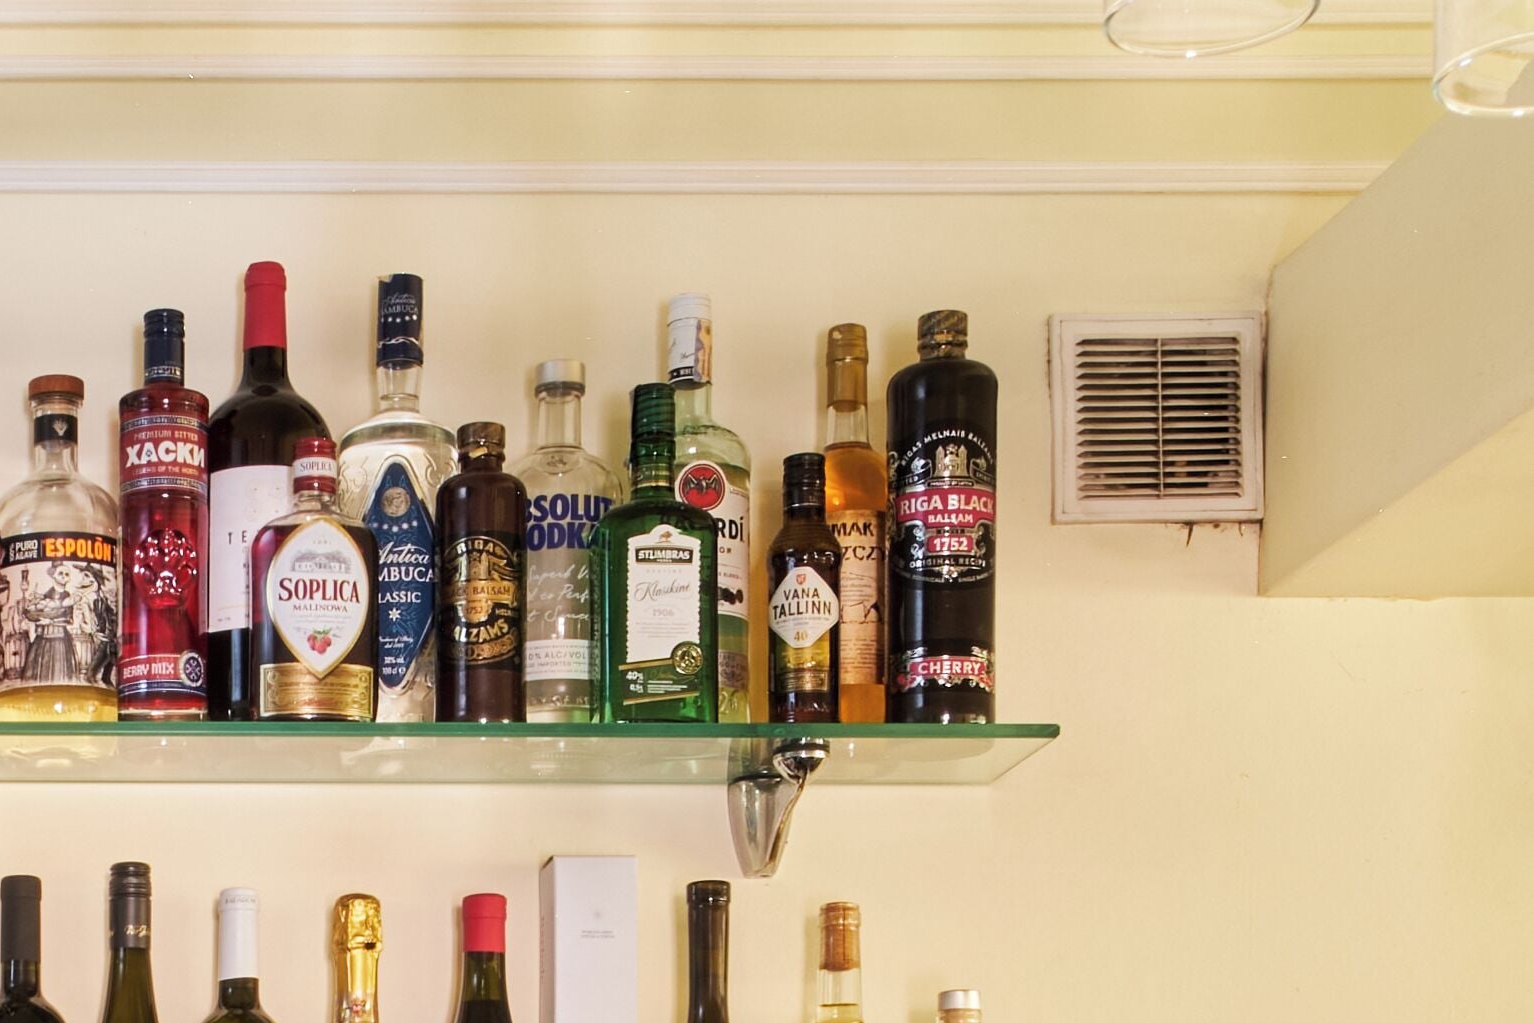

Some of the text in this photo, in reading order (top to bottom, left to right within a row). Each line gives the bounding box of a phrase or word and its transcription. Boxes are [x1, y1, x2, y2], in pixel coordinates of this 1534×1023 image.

[134, 430, 199, 441] PREMIUM BITTER
[924, 429, 966, 443] MELNAIS
[125, 440, 205, 469] ХАСКИ
[299, 461, 333, 473] SOPLICA
[900, 493, 994, 516] RIGA BLACK
[928, 513, 974, 524] BALSAM
[16, 539, 38, 550] PURO
[933, 537, 968, 551] 1752
[16, 550, 38, 560] AGAVE
[637, 549, 692, 561] STUMBRAS
[909, 558, 986, 569] ORIGINAL RECIPE
[278, 577, 361, 605] SOPLICA
[472, 584, 511, 597] BALSAM
[783, 588, 821, 602] VANA
[292, 604, 348, 613] MALINOWA
[772, 602, 832, 621] TALLINN
[794, 631, 808, 641] 40
[123, 661, 175, 680] BERRY MIX
[918, 660, 982, 676] CHERRY
